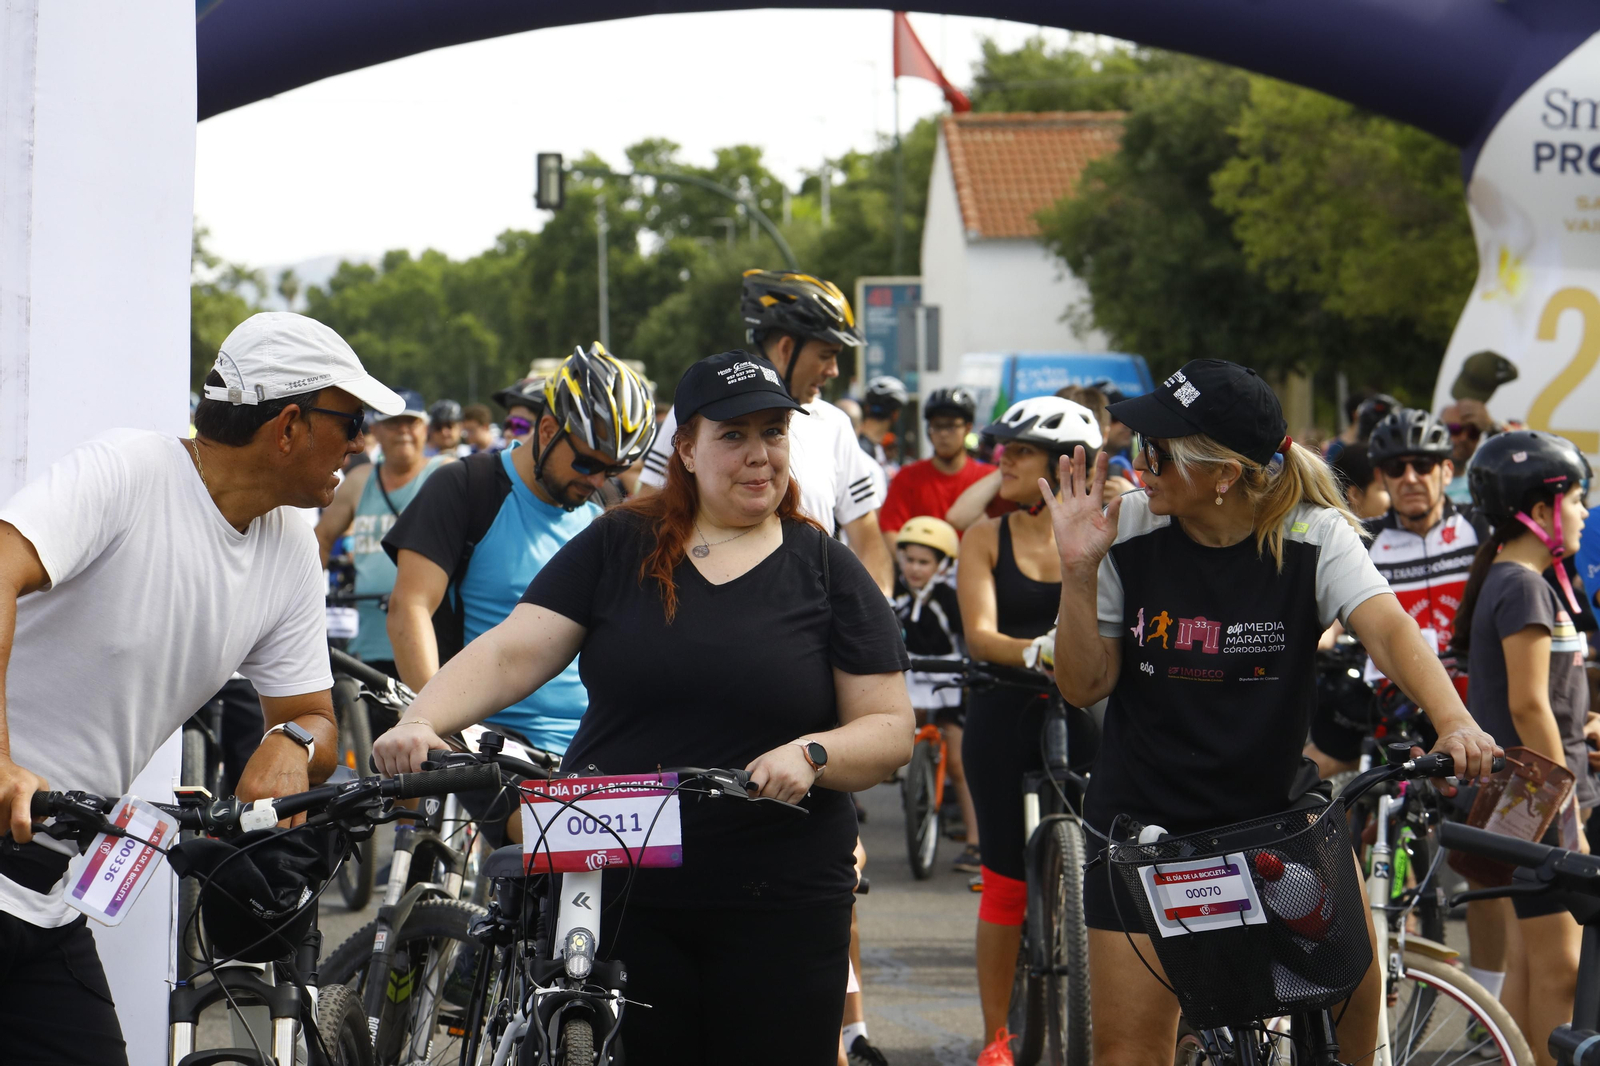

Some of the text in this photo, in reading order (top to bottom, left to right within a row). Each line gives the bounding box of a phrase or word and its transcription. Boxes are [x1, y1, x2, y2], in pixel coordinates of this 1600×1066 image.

[1226, 621, 1285, 635] edp MEDIA
[1225, 632, 1285, 645] MARATÓN
[1223, 646, 1268, 654] CÓRDOBA
[1140, 661, 1155, 676] edp
[1180, 667, 1224, 678] IMDECO
[534, 780, 665, 797] EL DÍA DE LA BICICLETA
[567, 813, 642, 836] 00211
[151, 835, 159, 843] EL
[104, 839, 136, 883] 00336
[139, 855, 148, 865] DE
[133, 863, 142, 872] LA
[1199, 869, 1226, 878] BICICLETA
[115, 872, 137, 902] BICICLETA
[1186, 886, 1221, 898] 00070
